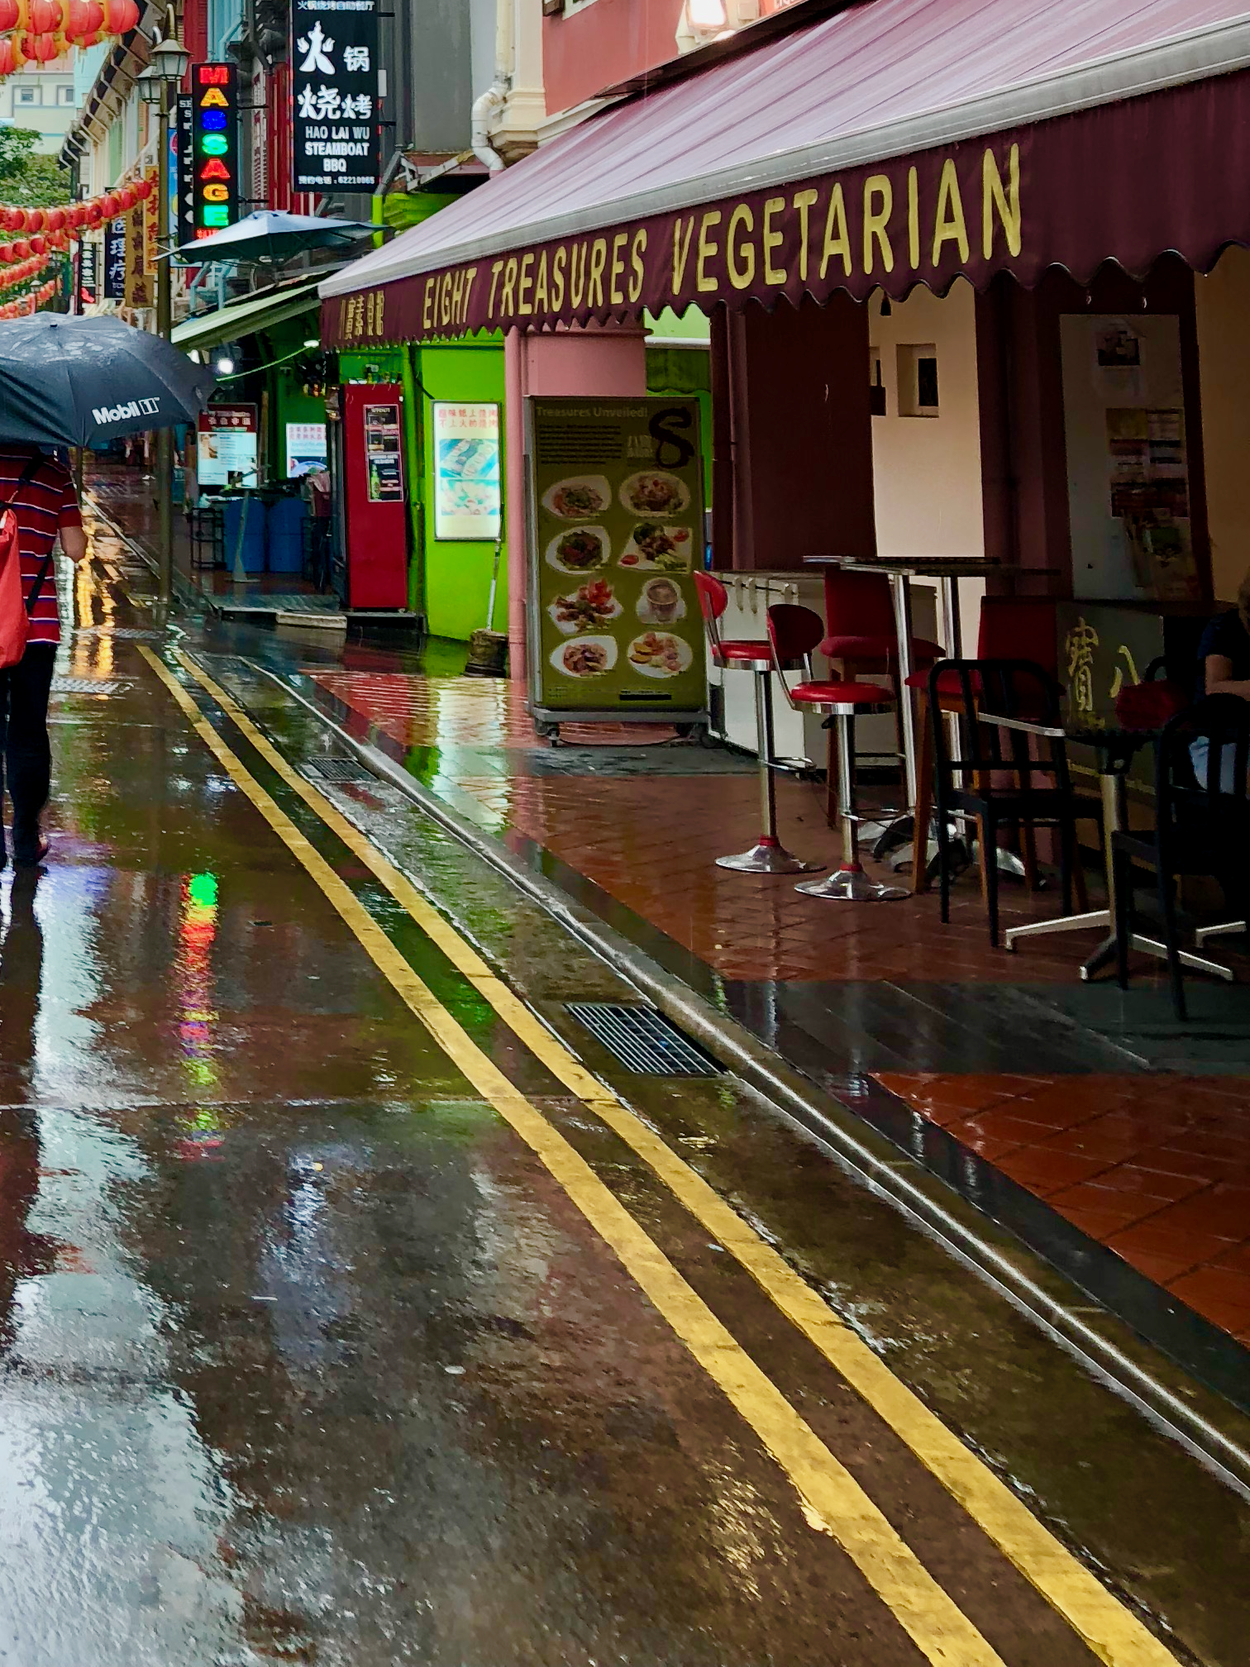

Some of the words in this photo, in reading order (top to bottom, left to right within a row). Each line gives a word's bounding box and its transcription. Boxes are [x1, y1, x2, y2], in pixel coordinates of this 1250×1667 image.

[296, 20, 370, 75] 火锅
[297, 83, 372, 120] 烧烤
[200, 66, 231, 227] MASSAGE
[305, 126, 328, 139] HAO
[332, 126, 350, 139] LAI
[352, 126, 370, 139] WU
[305, 141, 370, 156] STEAMBOAT
[323, 158, 347, 172] BBQ
[423, 267, 477, 329] EIGHT
[488, 228, 647, 319] TREASURES
[672, 142, 1022, 296] VEGETARIAN
[92, 401, 140, 425] Mobil
